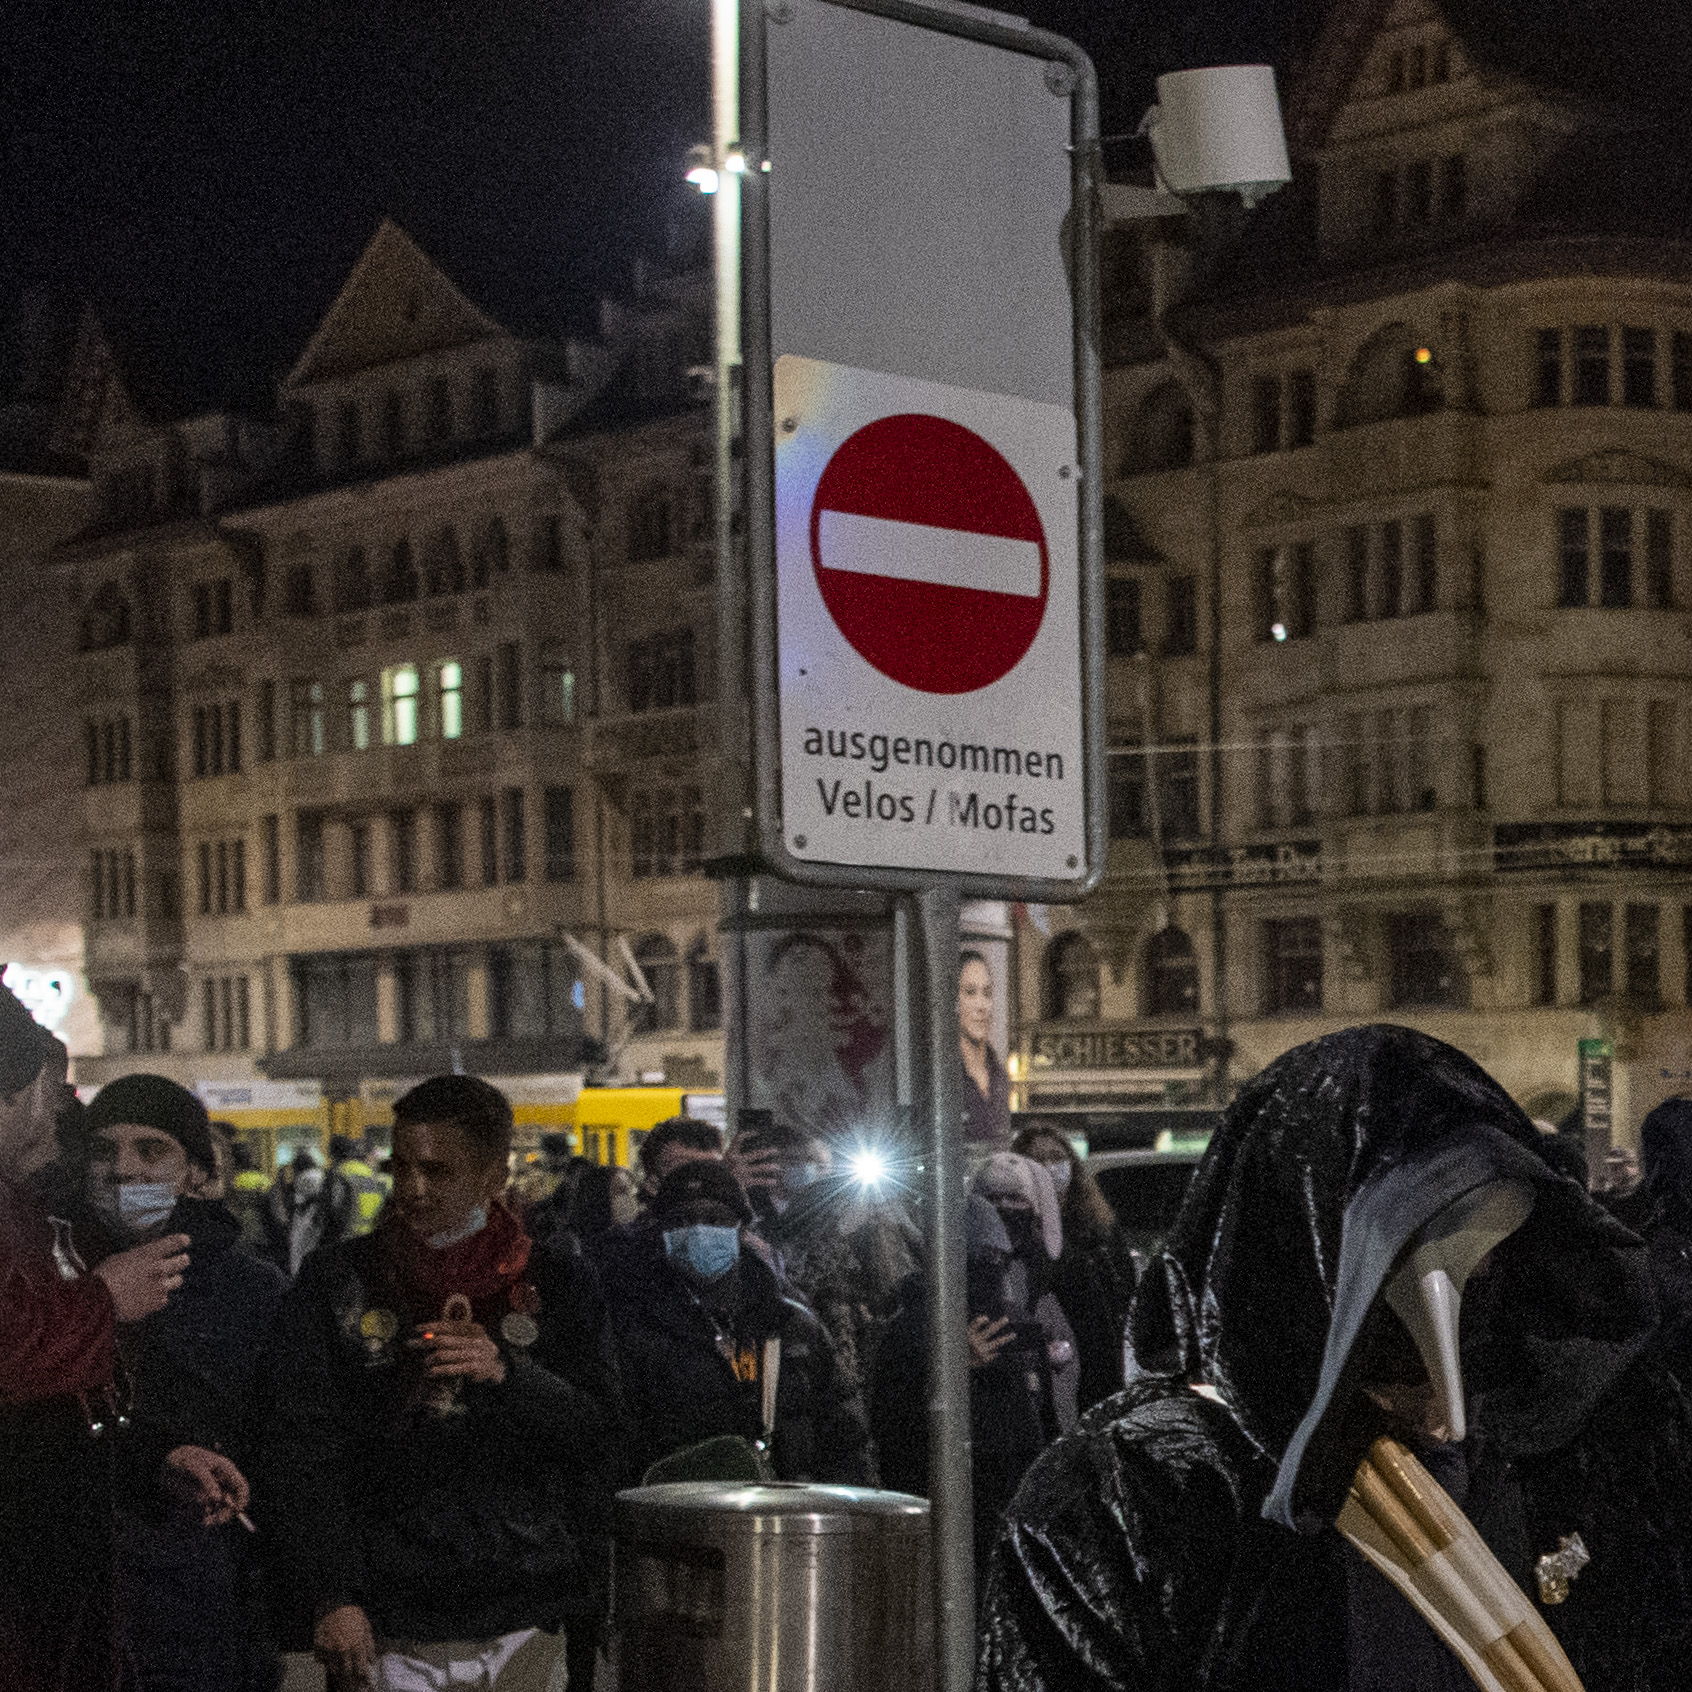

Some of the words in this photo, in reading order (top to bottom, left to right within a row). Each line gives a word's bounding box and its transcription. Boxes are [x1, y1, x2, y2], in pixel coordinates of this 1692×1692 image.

[804, 726, 1064, 780] ausgenommen
[817, 778, 915, 823] Velos
[926, 788, 937, 824] /
[949, 790, 1056, 835] Mofas
[1034, 1033, 1197, 1067] SCHIESSER
